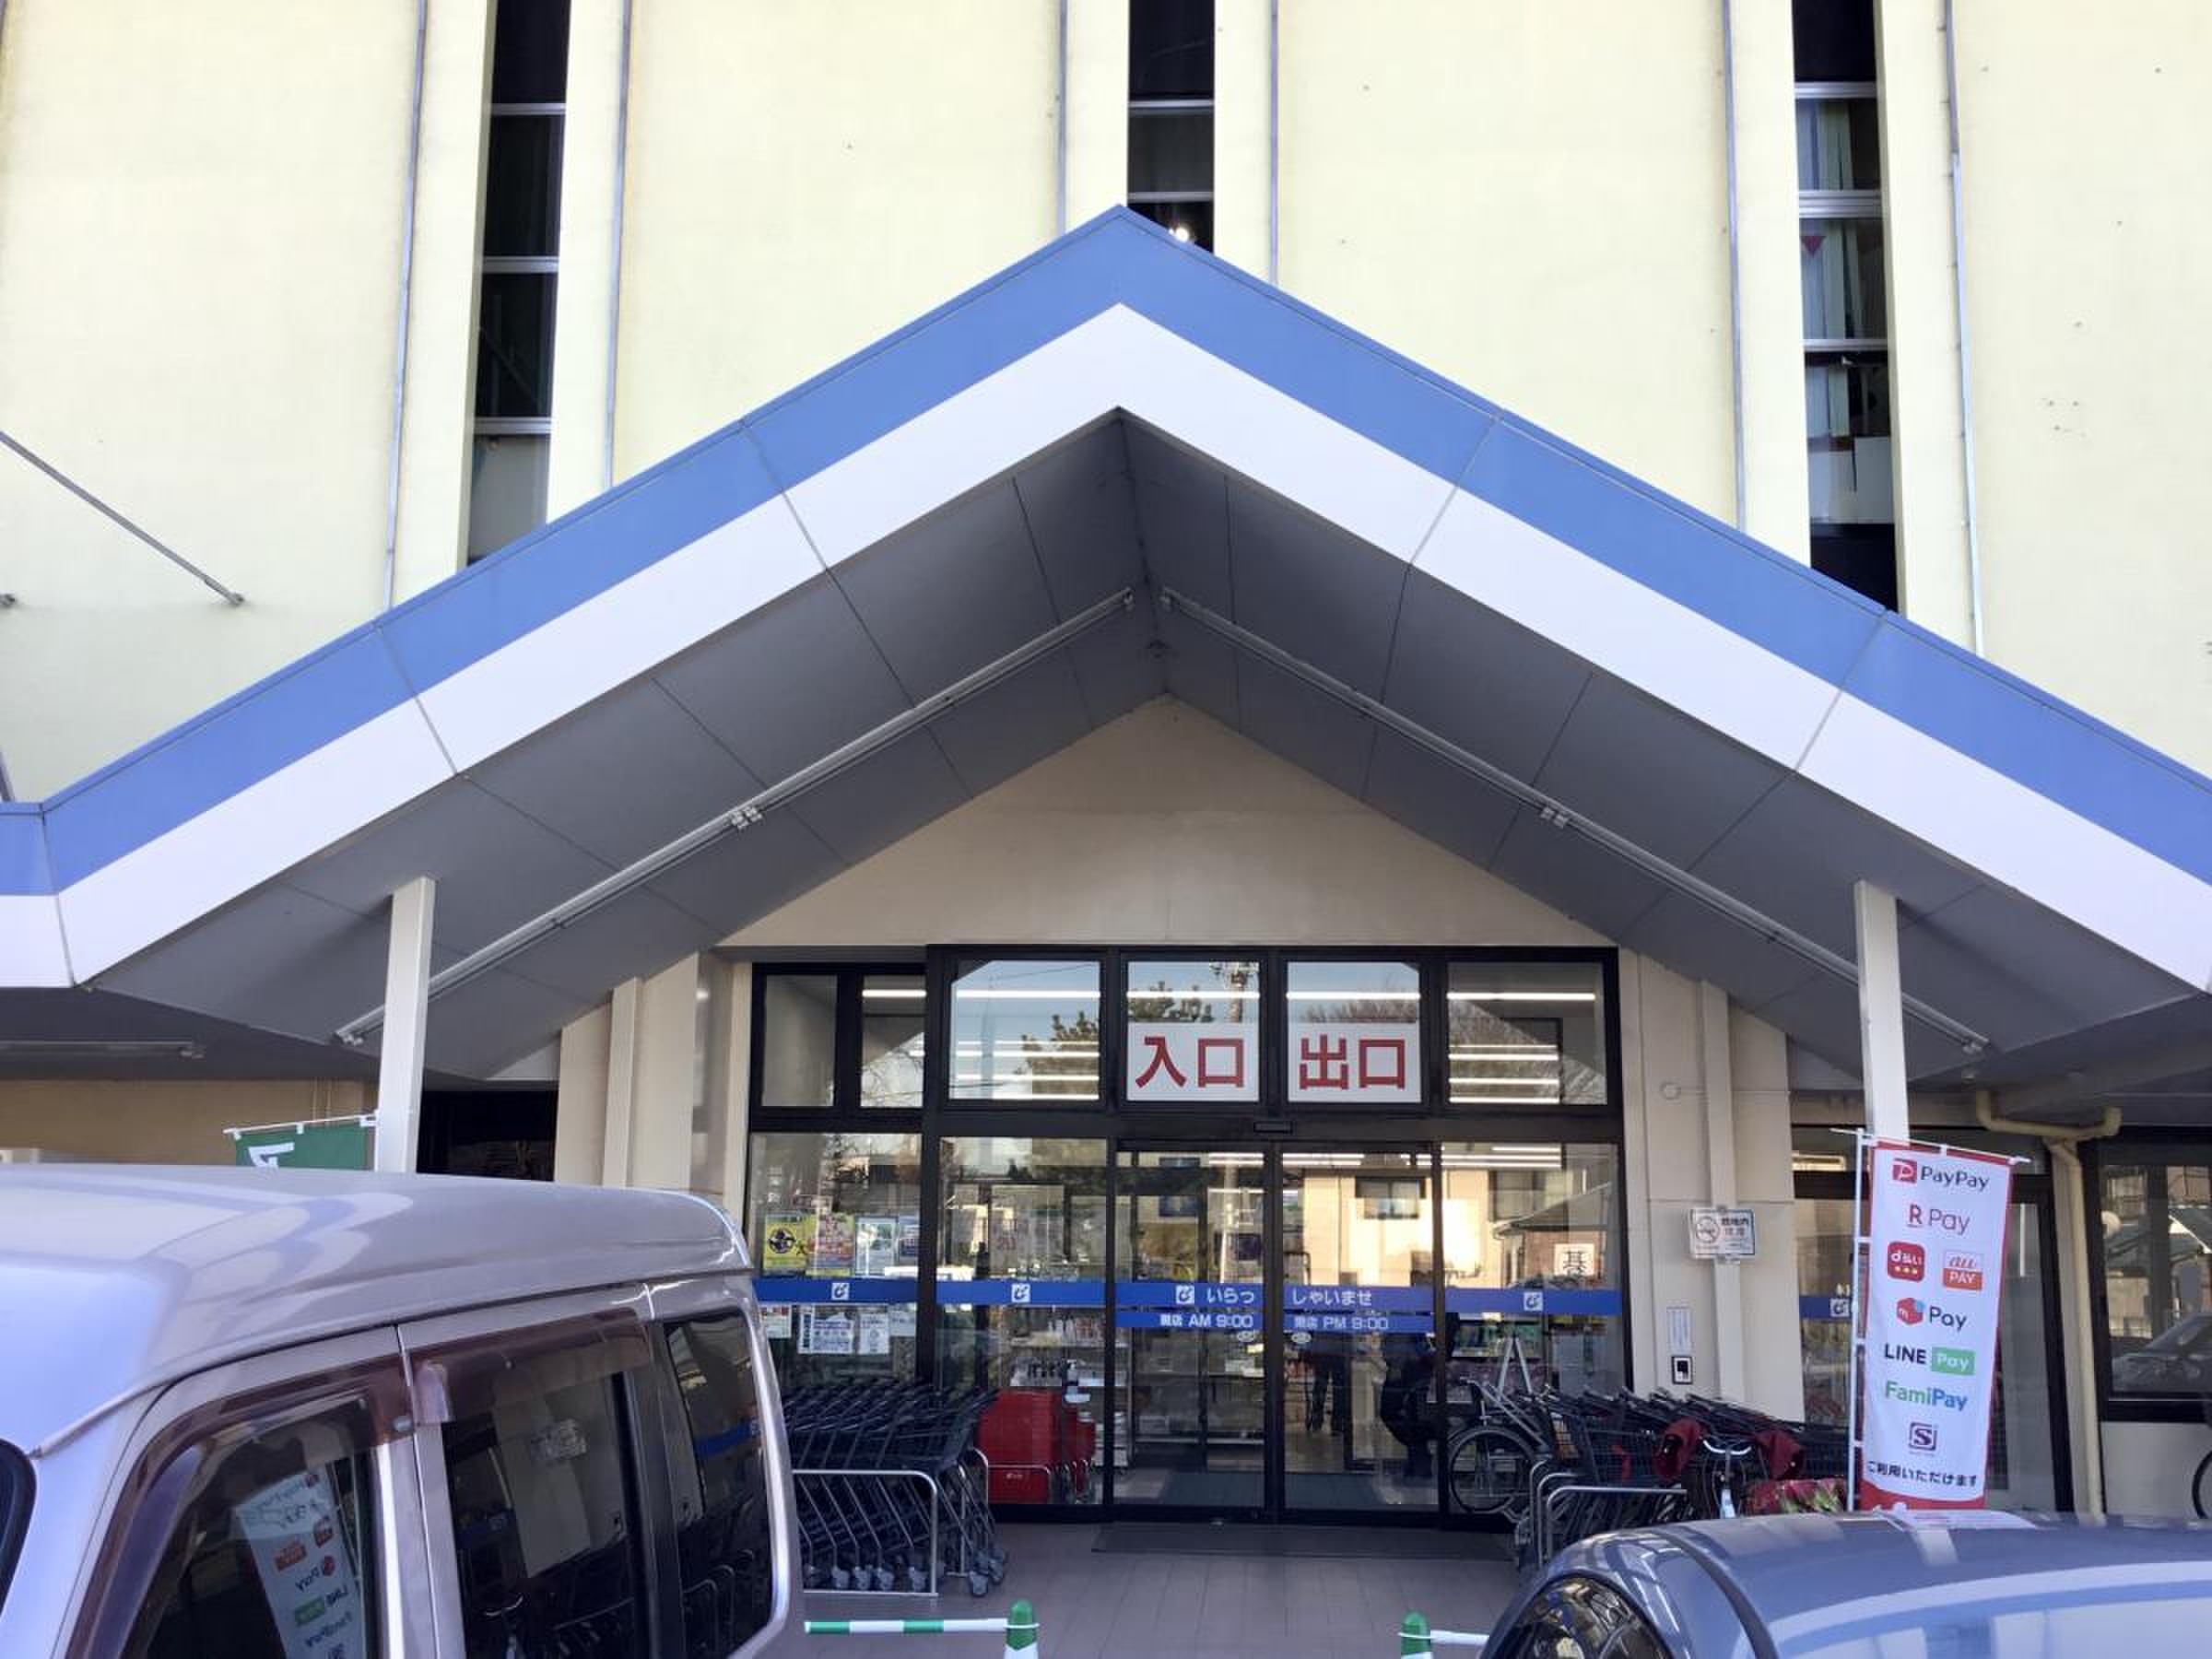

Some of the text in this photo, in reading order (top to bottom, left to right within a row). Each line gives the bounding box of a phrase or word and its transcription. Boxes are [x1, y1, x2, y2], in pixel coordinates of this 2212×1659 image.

[1135, 1035, 1244, 1088] 入口
[1299, 1034, 1406, 1090] 出口
[1921, 1166, 1990, 1192] PayPay
[1908, 1204, 1971, 1235] R Pay
[1948, 1271, 1977, 1285] PAY
[1206, 1288, 1254, 1304] いらっ
[1292, 1288, 1372, 1306] しゃいませ
[1188, 1314, 1211, 1327] AM
[1323, 1316, 1347, 1329] PM
[1929, 1305, 1968, 1332] Pay
[1884, 1344, 1970, 1371] LINE Pay
[1885, 1380, 1970, 1411] FamiPay
[1866, 1461, 1977, 1488] ご利用いただけます
